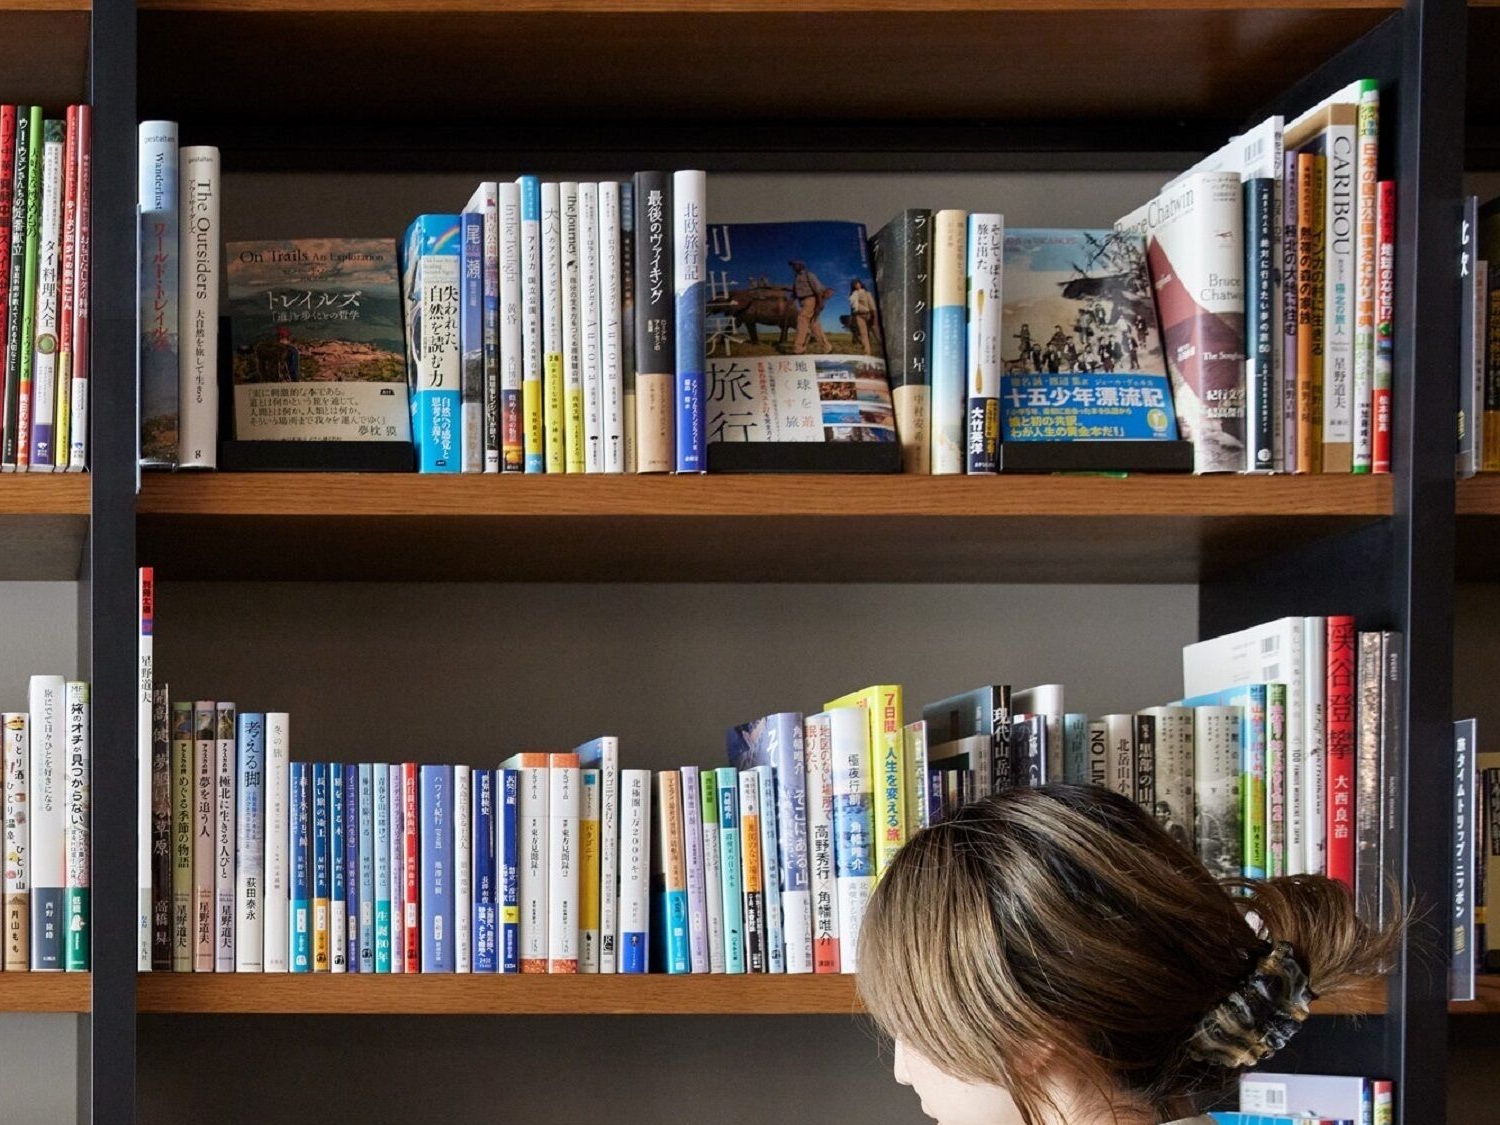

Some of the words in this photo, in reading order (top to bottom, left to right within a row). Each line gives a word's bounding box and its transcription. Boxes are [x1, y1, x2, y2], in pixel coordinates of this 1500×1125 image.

[196, 179, 212, 206] The
[1332, 136, 1353, 256] CARIBOU
[195, 212, 212, 300] Outsiders
[267, 248, 309, 264] Trails
[648, 190, 665, 305] 最後のヴァイキング
[683, 202, 699, 281] 北欧旅行記
[267, 291, 360, 310] トレイルズ
[911, 214, 928, 374] ラダックの星
[428, 285, 445, 389] 自然を読む力
[1004, 387, 1165, 407] 十五少年漂流記
[140, 655, 153, 703] 星野道夫
[244, 720, 261, 788] 考える脚
[177, 776, 190, 869] めぐる季節の物語
[218, 775, 231, 880] 極北に生きる人びと
[1333, 774, 1349, 840] 大西良治
